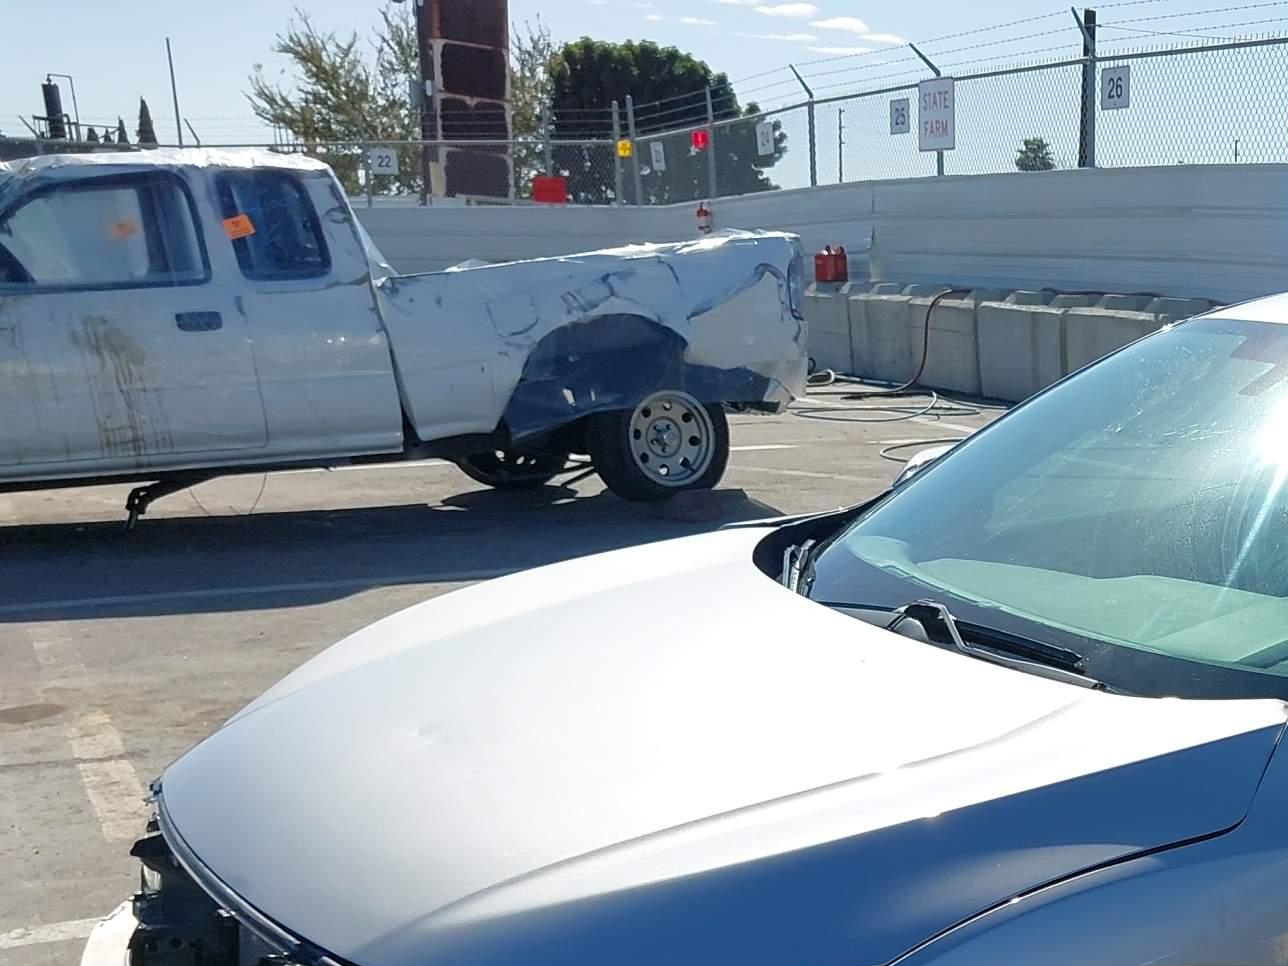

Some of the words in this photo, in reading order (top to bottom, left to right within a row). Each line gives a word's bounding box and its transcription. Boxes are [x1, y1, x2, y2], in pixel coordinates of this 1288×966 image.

[1107, 76, 1123, 100] 26
[922, 90, 950, 112] STATE
[894, 107, 906, 126] 25
[923, 119, 949, 140] FARM
[376, 154, 392, 168] 22
